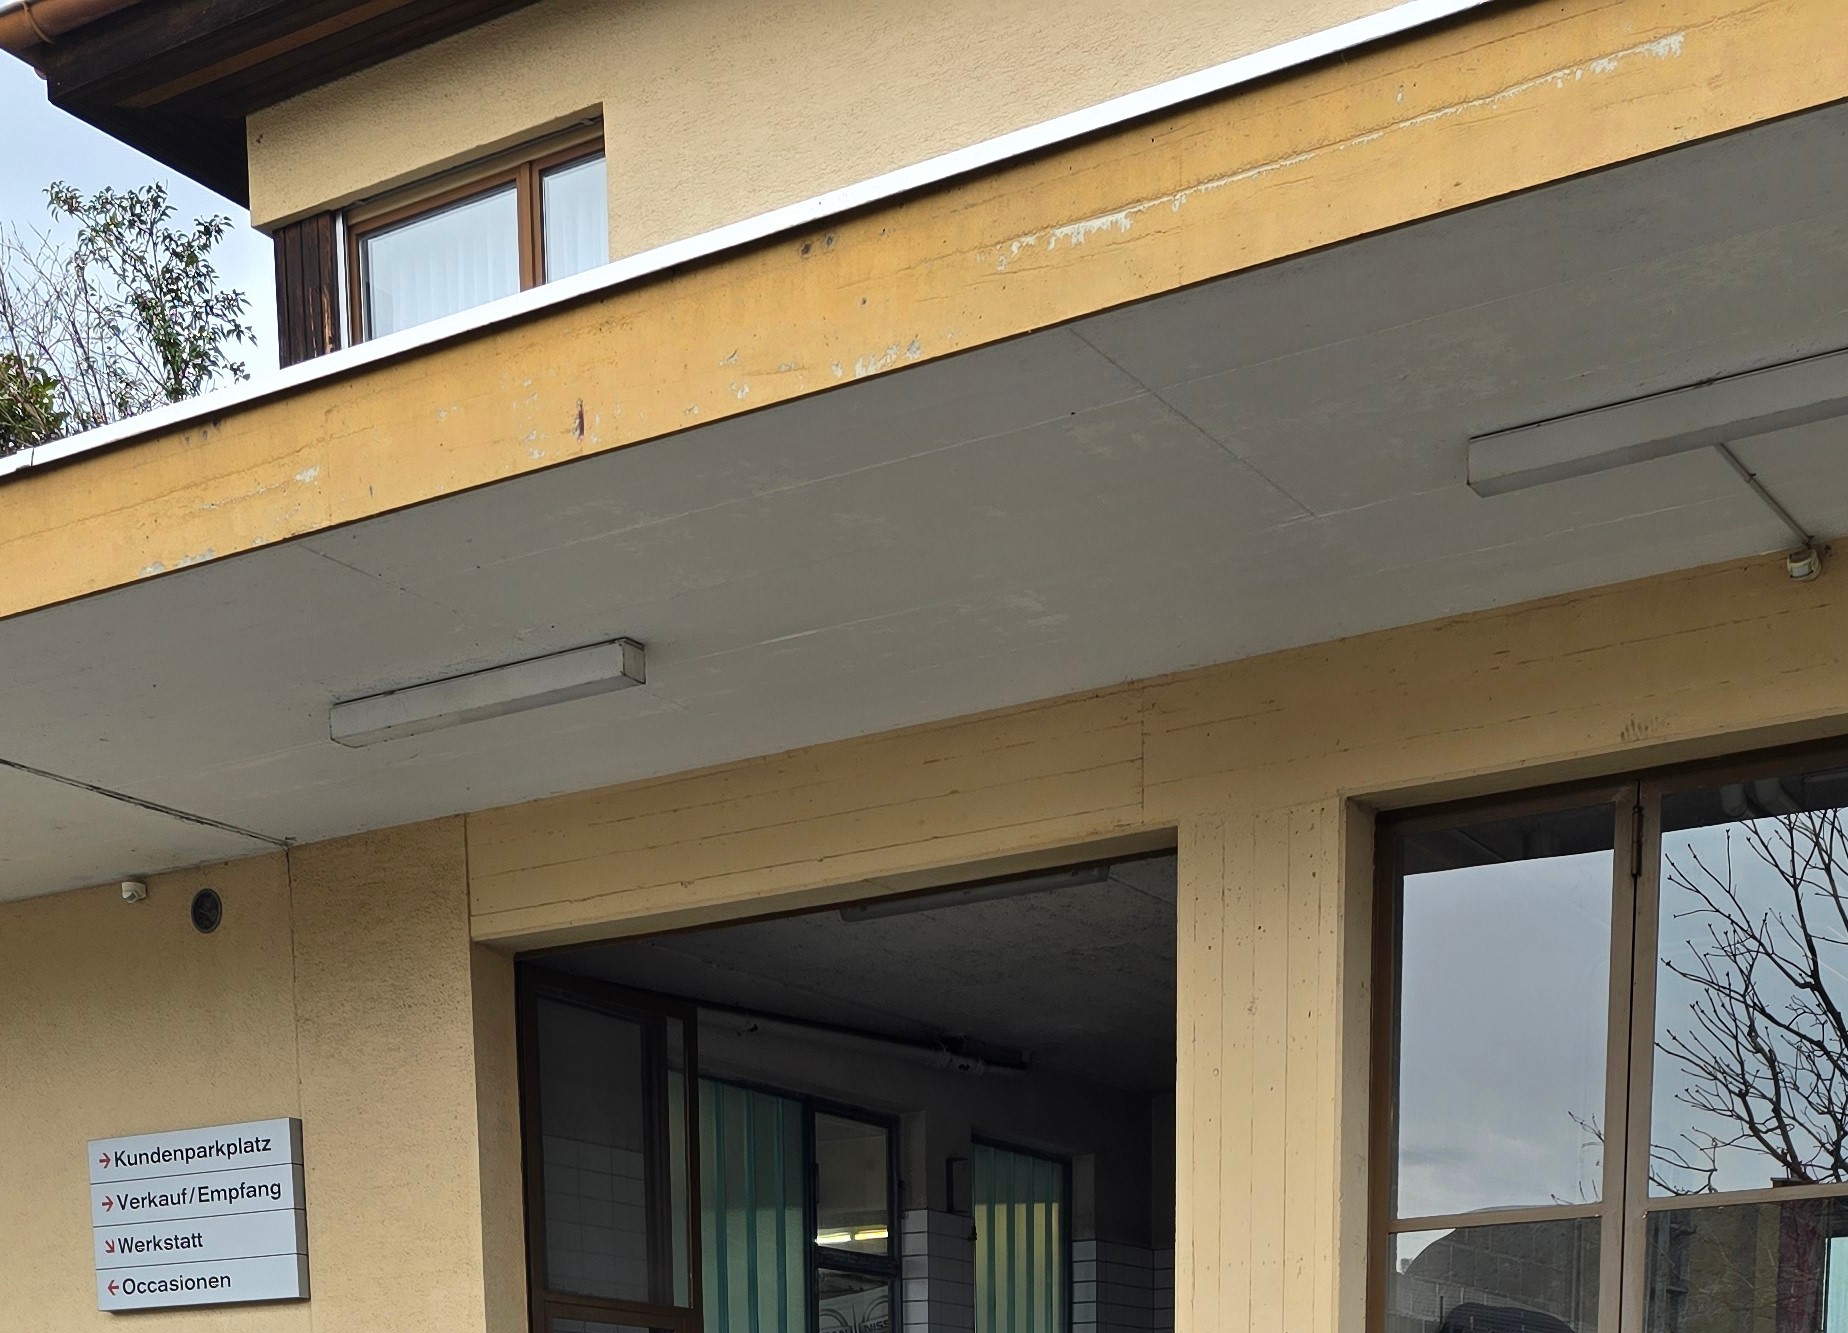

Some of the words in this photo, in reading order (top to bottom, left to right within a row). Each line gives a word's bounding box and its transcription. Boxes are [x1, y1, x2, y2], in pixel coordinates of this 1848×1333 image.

[114, 1136, 272, 1168] Kundenparkplatz
[118, 1233, 203, 1254] Werkstatt
[122, 1274, 231, 1296] Occasionen
[864, 1318, 889, 1332] NISS
